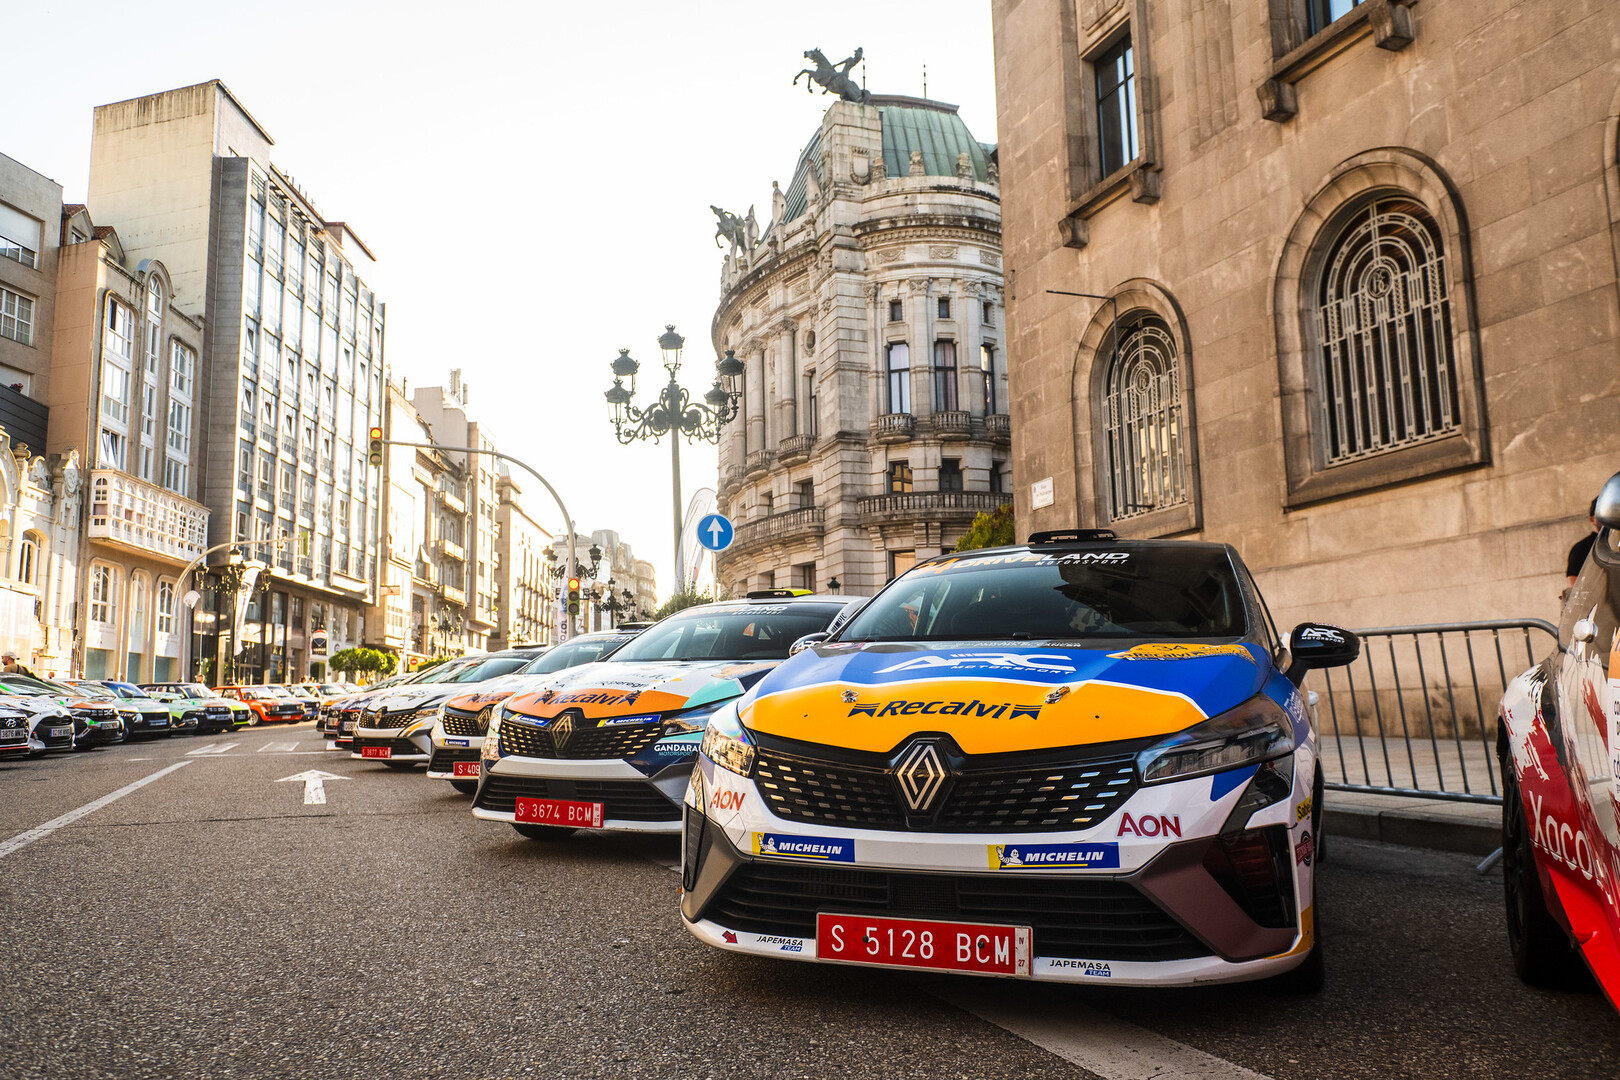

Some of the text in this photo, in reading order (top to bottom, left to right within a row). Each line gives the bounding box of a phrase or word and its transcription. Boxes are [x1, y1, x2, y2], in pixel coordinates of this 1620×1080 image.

[1034, 559, 1128, 567] MOTORSPORT
[1301, 627, 1345, 641] ARC
[1301, 635, 1346, 644] MOTORSPORT
[872, 652, 1078, 674] ARC
[949, 664, 1077, 676] MOTORSPORT
[552, 691, 623, 707] Recalvi
[877, 699, 1011, 720] Recalvi
[615, 716, 654, 724] MICHELIN
[653, 743, 699, 753] GANDARA
[458, 764, 464, 775] S
[709, 786, 746, 812] AON
[517, 801, 592, 823] S 3674 BCM
[1117, 812, 1182, 838] AON
[778, 841, 843, 856] MICHELIN
[1024, 850, 1105, 863] MICHELIN
[757, 935, 803, 947] JAPEMASA
[831, 924, 1010, 966] S 5128 BCM
[784, 944, 801, 952] TEAM
[1018, 958, 1026, 968] 27
[1049, 959, 1111, 971] JAPEMASA
[1088, 969, 1110, 977] TEAM
